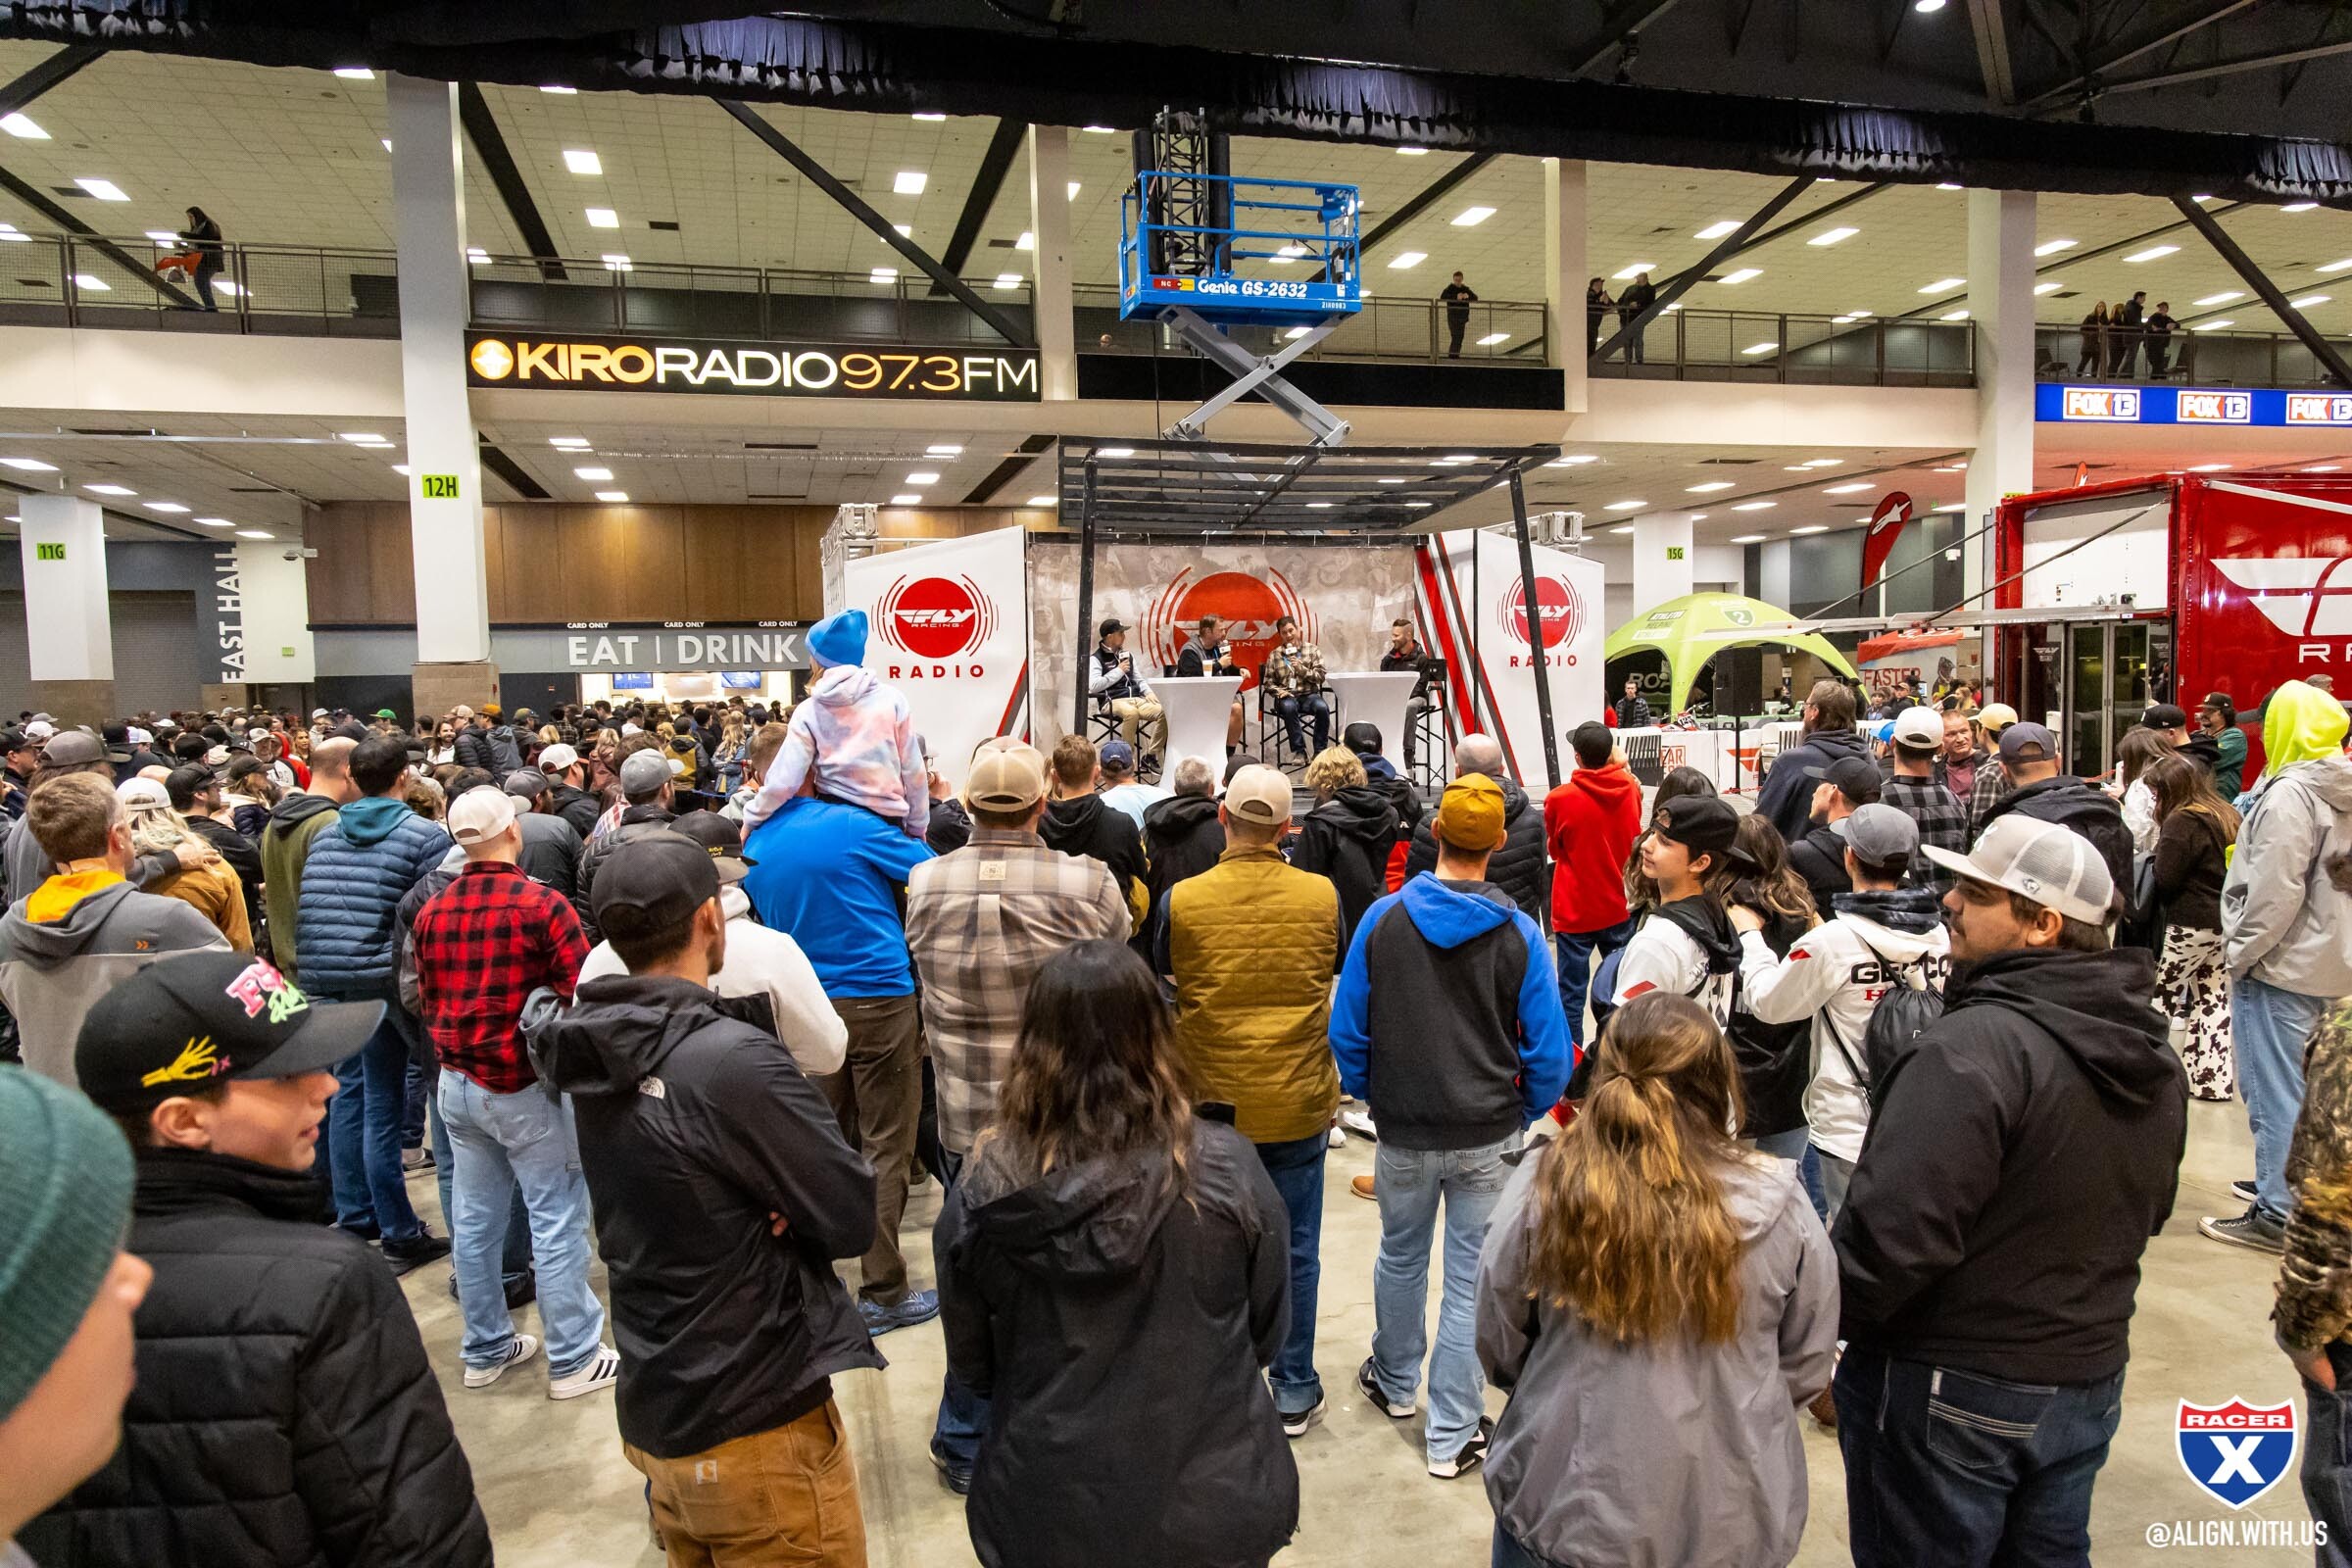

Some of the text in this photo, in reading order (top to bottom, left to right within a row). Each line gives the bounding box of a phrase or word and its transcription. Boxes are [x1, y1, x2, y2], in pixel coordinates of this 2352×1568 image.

[1198, 278, 1307, 298] Genie GS-2632
[2068, 392, 2136, 416] FOX 13
[2181, 395, 2248, 419] FOX 13
[2290, 398, 2329, 419] FOX
[424, 477, 458, 497] 12H
[40, 545, 65, 560] 11G
[1668, 548, 1683, 560] 15G
[215, 548, 245, 683] EAST HALL
[895, 609, 976, 623] FLY
[1733, 611, 1749, 624] 2
[567, 633, 800, 666] EAT DRINK
[889, 664, 984, 678] RADIO
[1851, 954, 1952, 984] GECO
